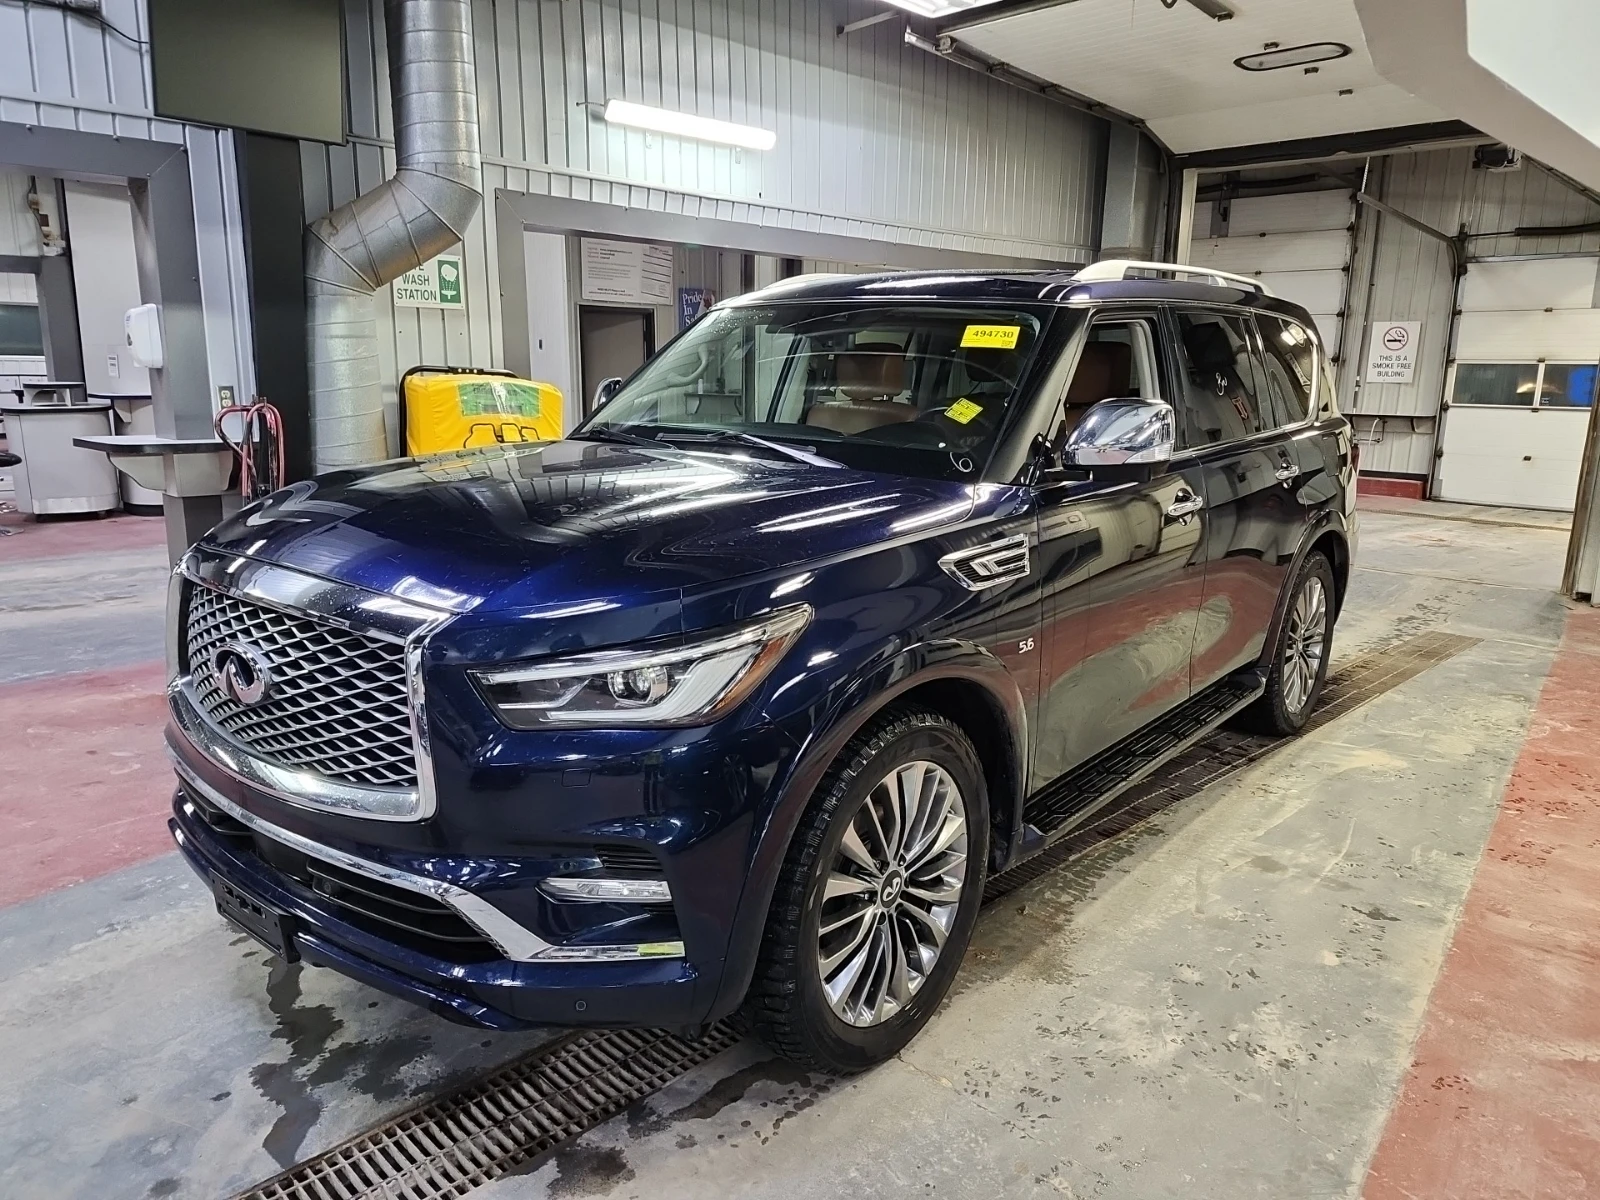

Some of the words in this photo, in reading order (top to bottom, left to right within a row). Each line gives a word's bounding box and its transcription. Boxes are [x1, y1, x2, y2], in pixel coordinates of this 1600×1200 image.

[402, 273, 430, 286] WASH
[396, 288, 437, 301] STATION
[683, 291, 702, 304] Pride
[684, 304, 693, 316] In
[972, 330, 1014, 339] 494730
[1018, 637, 1035, 654] 5.6
